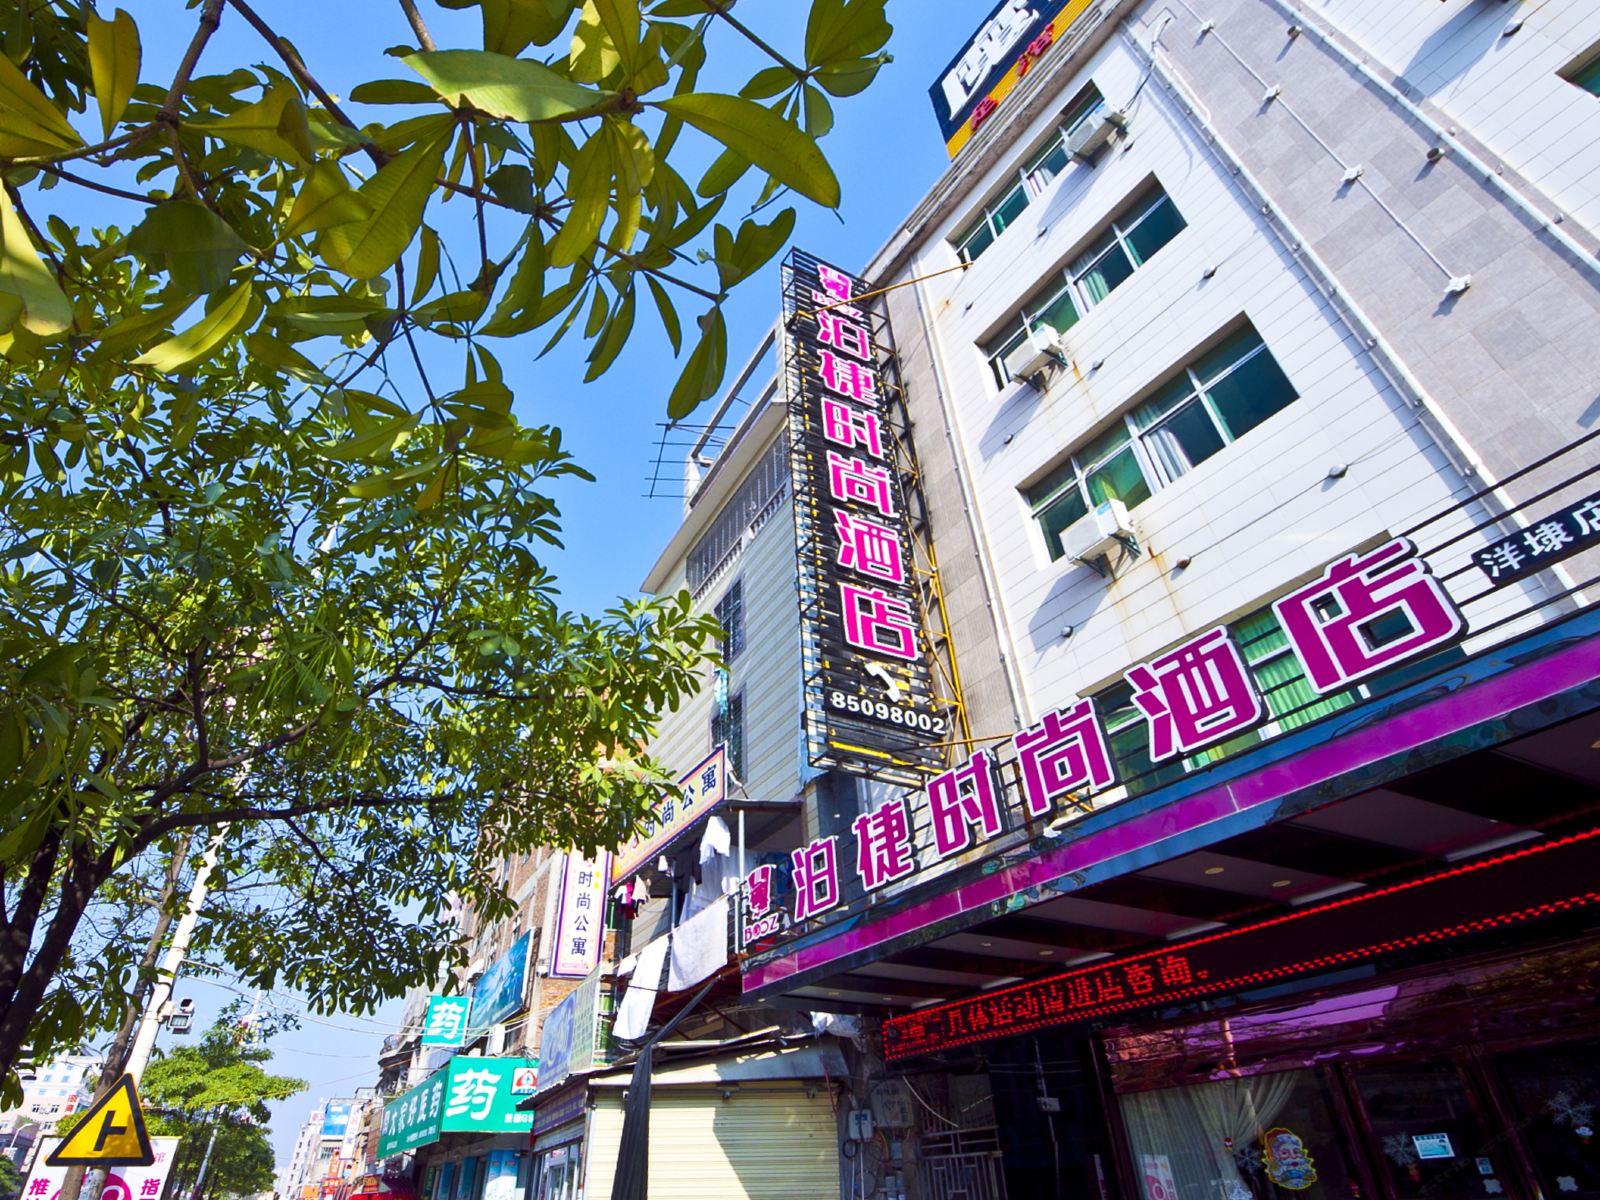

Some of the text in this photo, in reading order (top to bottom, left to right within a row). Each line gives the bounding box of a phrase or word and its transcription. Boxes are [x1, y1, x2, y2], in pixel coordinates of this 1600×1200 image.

[815, 306, 919, 661] 泊捷时尚酒店
[791, 537, 1464, 923] 泊捷时尚酒店
[830, 691, 946, 734] 85098002
[571, 871, 593, 956] 时尚公寓
[427, 1001, 465, 1039] 药
[446, 1069, 502, 1121] 药
